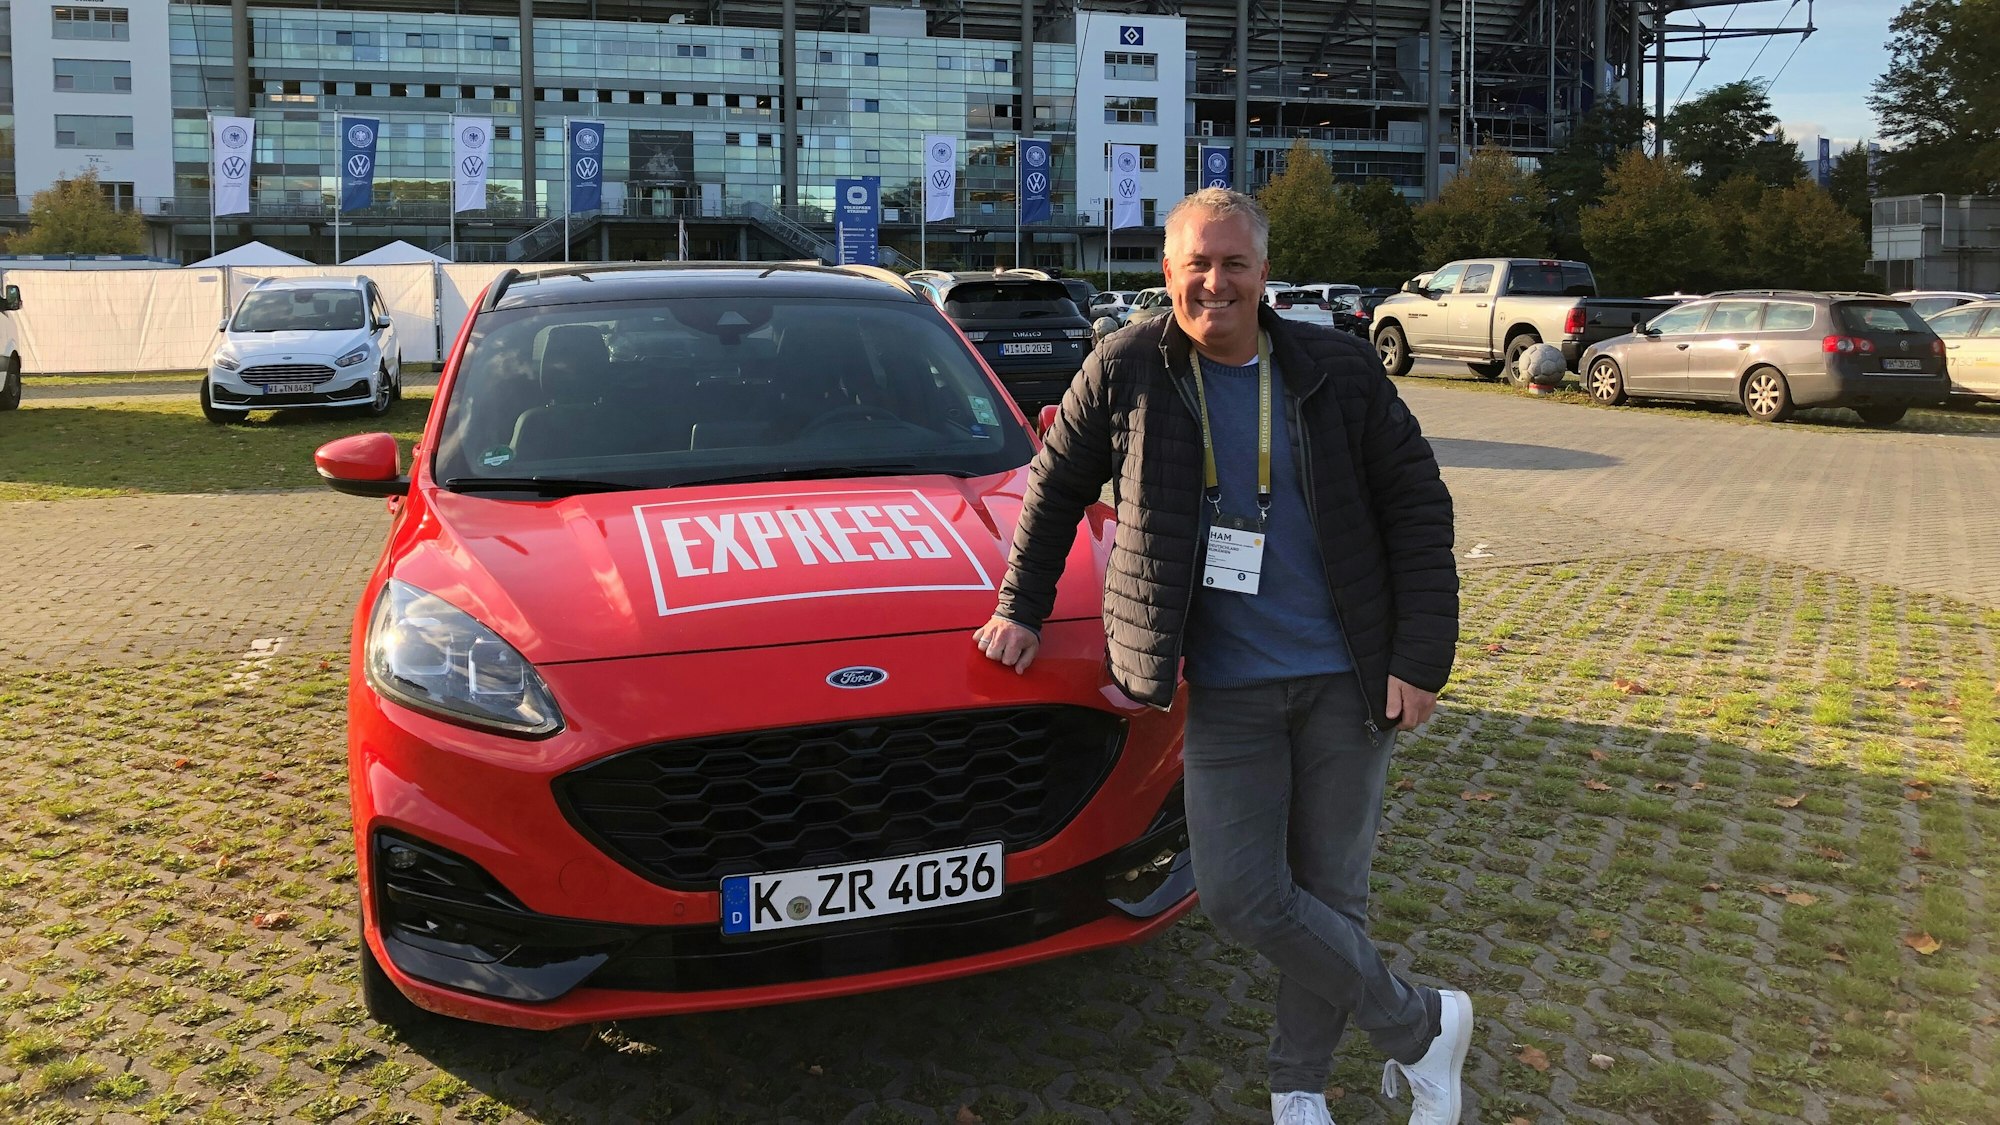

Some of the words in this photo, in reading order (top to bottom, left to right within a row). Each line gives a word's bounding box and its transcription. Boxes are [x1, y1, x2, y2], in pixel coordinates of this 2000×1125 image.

[661, 504, 952, 578] EXPRESS
[1210, 531, 1232, 541] HAM
[840, 669, 874, 685] Ford
[731, 911, 743, 925] D
[754, 879, 783, 925] K
[817, 868, 877, 918] ZR
[887, 851, 996, 906] 4036
